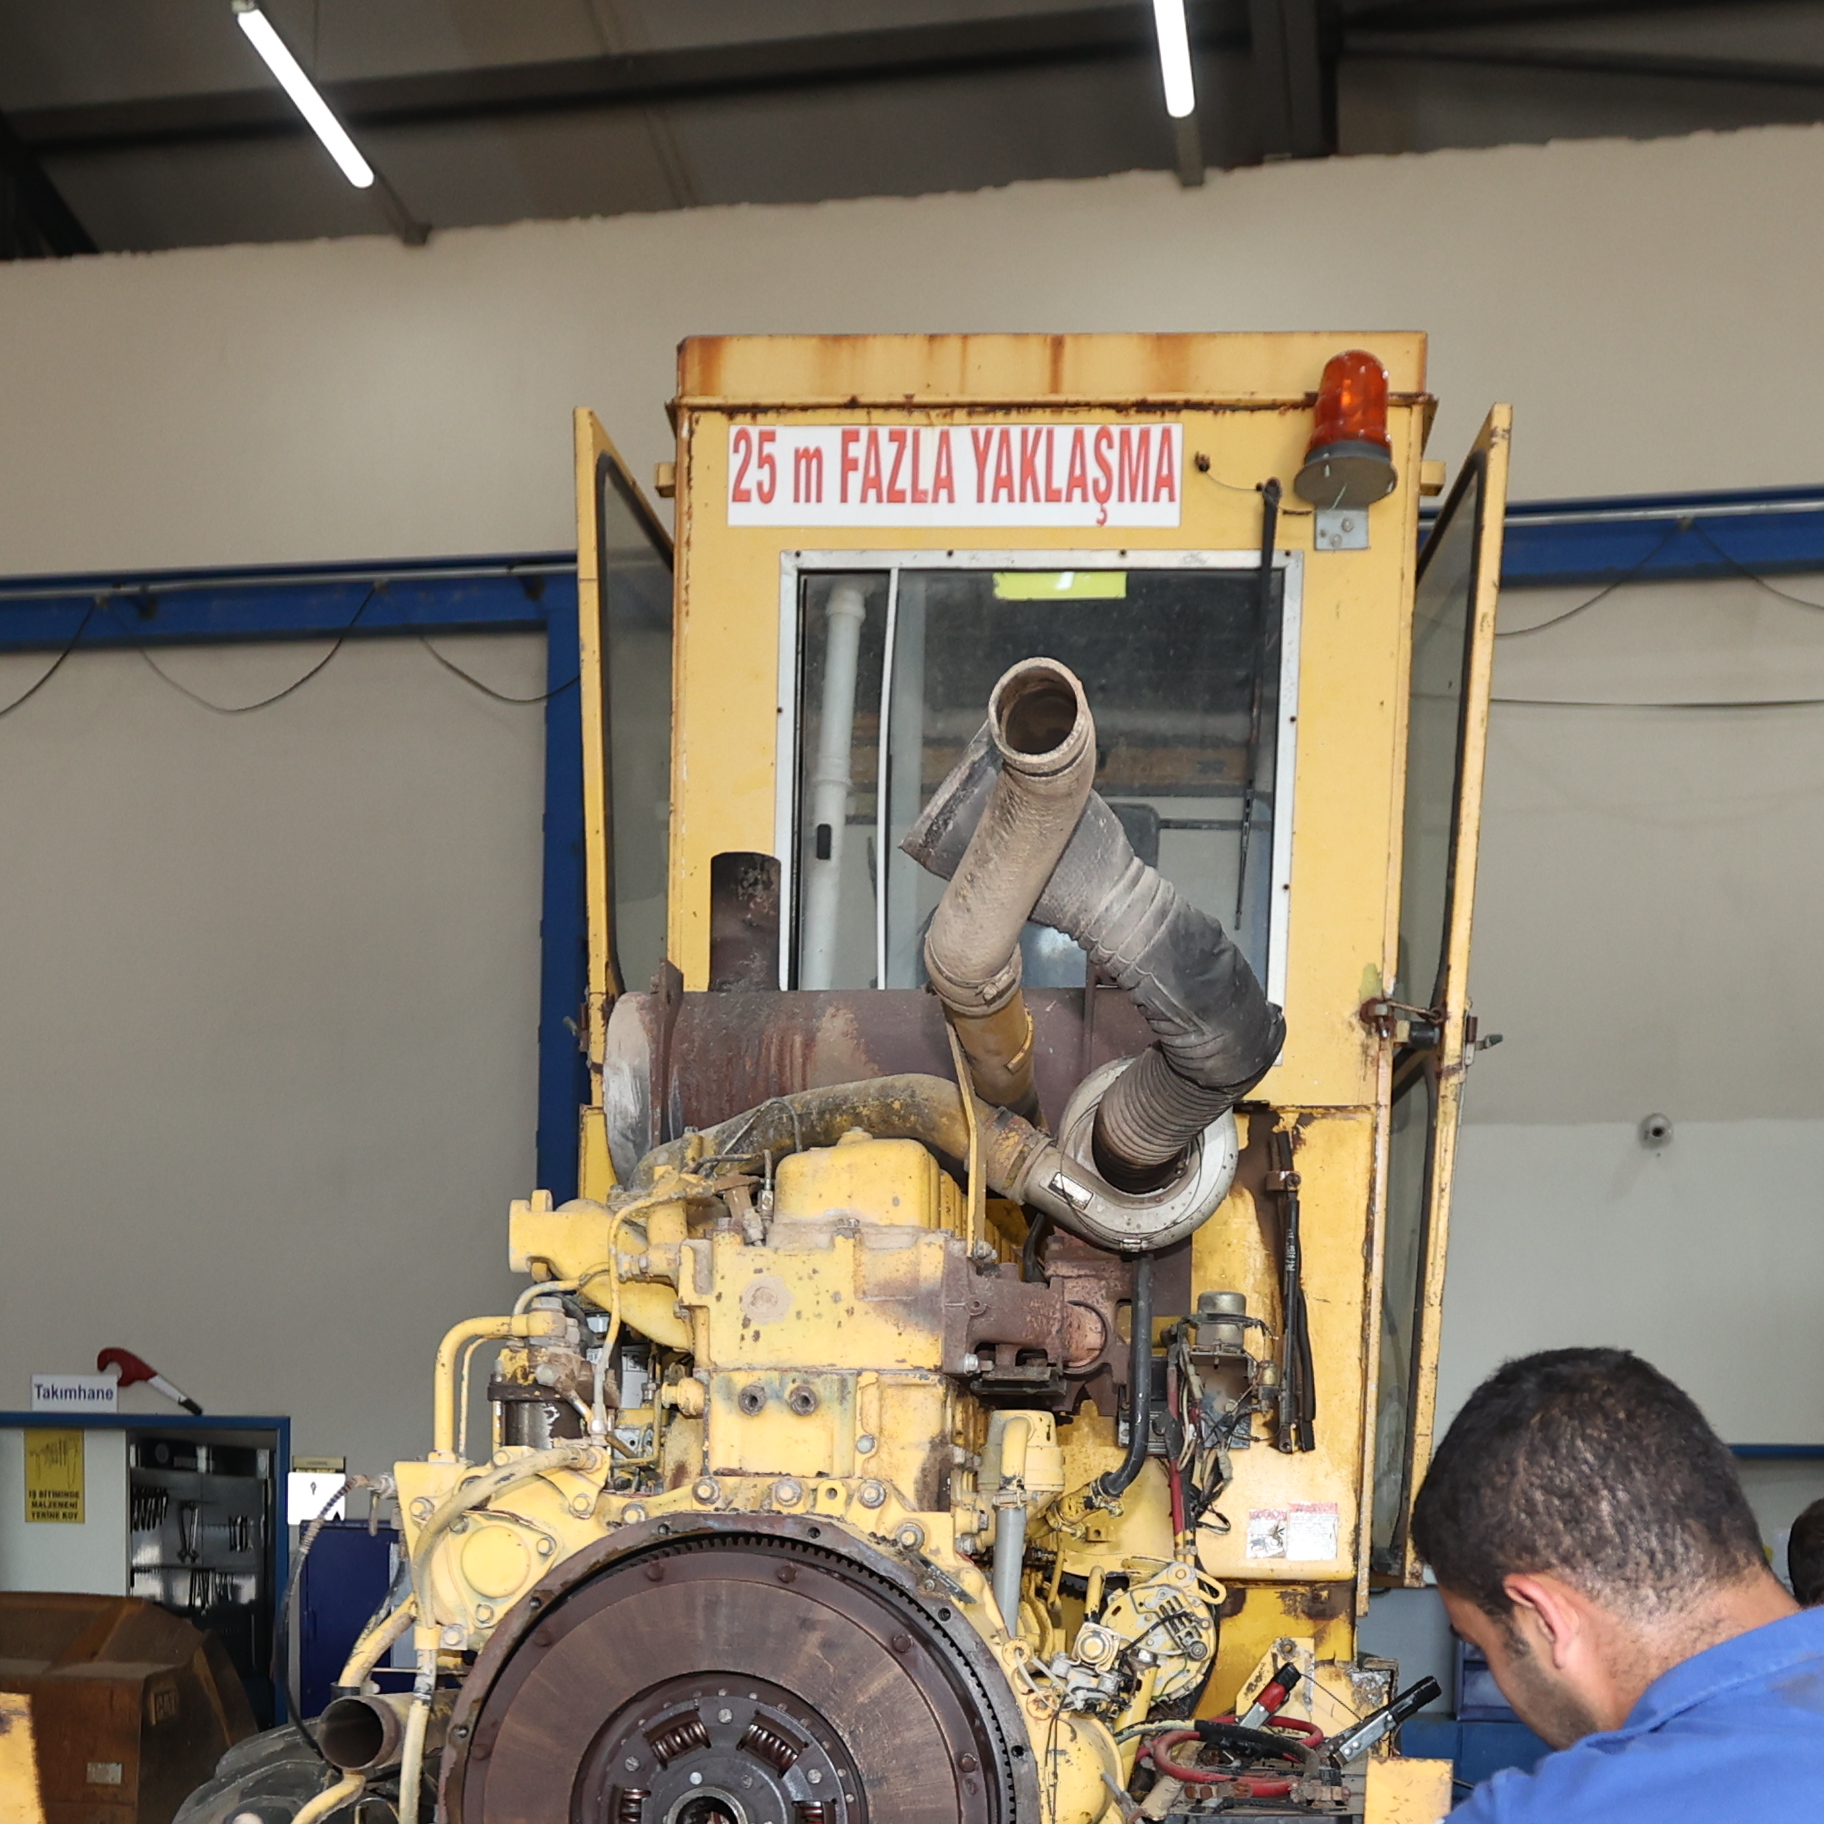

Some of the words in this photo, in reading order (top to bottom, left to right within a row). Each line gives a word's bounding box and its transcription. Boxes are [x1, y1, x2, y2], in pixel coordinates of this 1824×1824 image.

[731, 426, 777, 505] 25
[793, 445, 824, 504] m
[839, 427, 956, 504] FAZLA
[971, 424, 1177, 527] YAKLAŞMA
[34, 1384, 114, 1400] Takımhane
